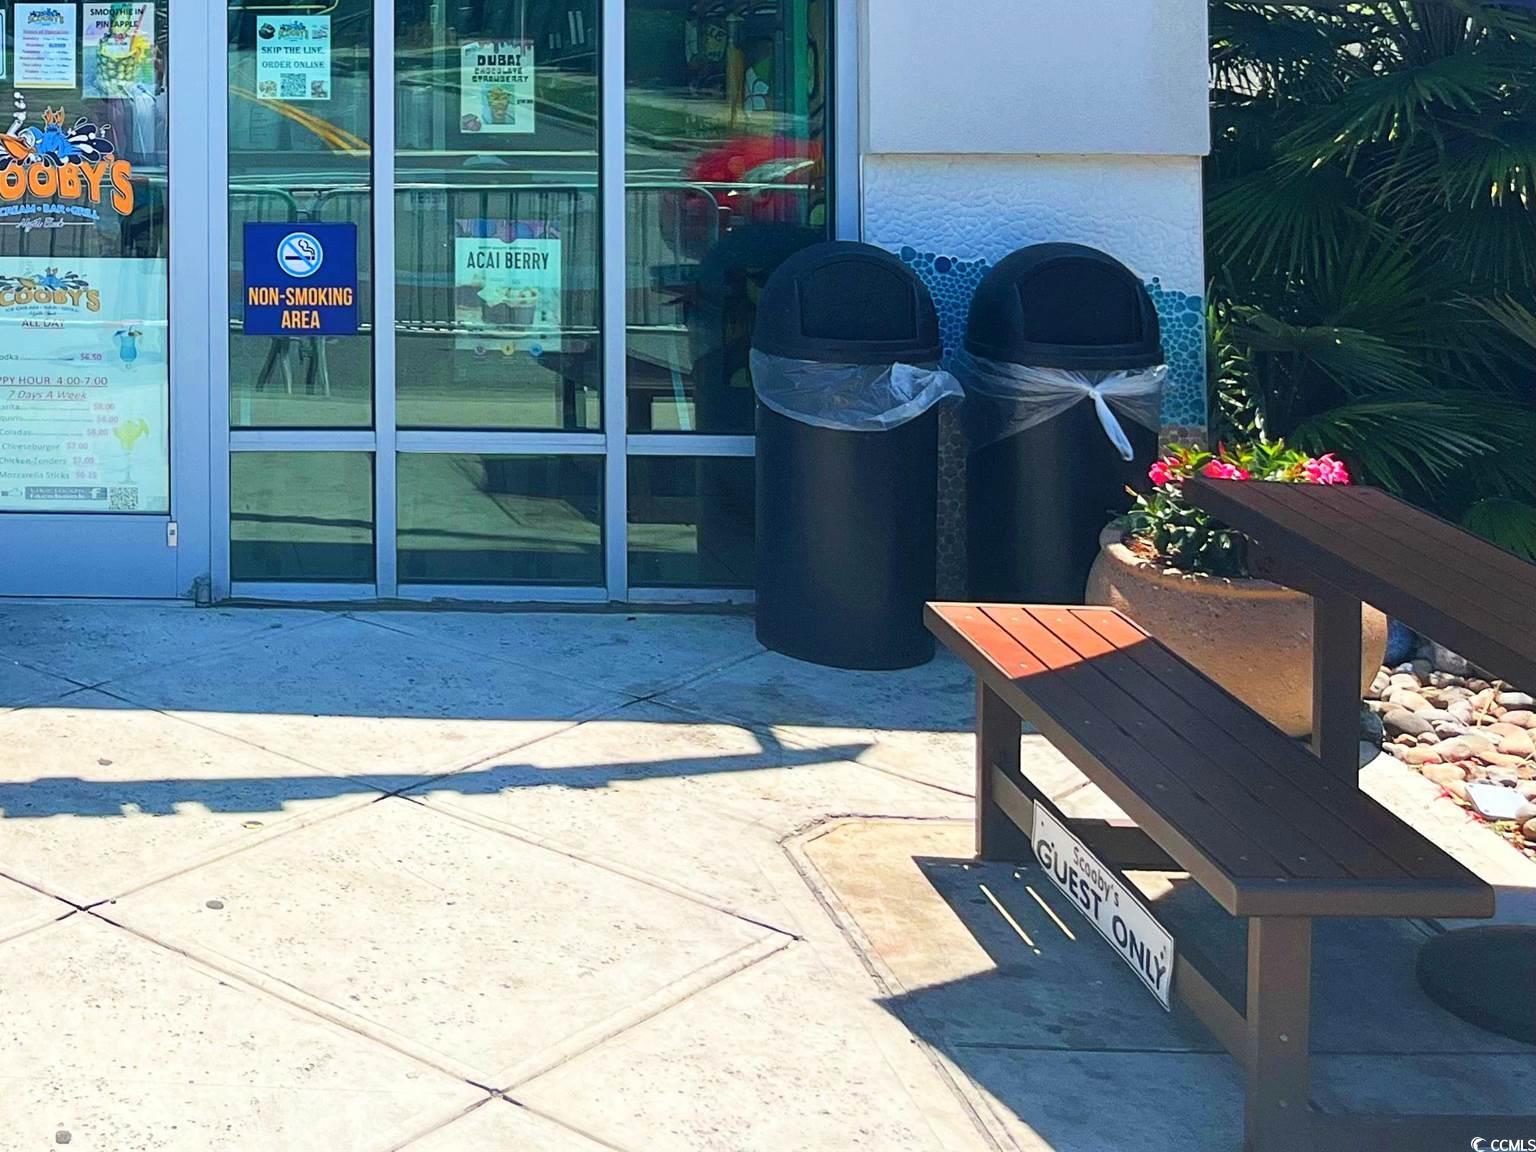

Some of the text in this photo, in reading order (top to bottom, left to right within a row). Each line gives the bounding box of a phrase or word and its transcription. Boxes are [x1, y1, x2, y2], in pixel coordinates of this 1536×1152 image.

[90, 8, 144, 16] SMOOTHIE IN
[96, 20, 139, 28] PINEAPPLE
[261, 46, 282, 54] SKIP
[284, 46, 301, 54] THE
[262, 61, 325, 69] ORDER ONLINE
[477, 54, 521, 66] DUBAI
[467, 251, 549, 270] ACAI BERRY
[248, 287, 353, 306] NON-SMOKING
[21, 320, 40, 328] ALL
[281, 310, 321, 329] AREA
[8, 390, 87, 401] 7 Days A Week
[1073, 845, 1120, 908] Scooby's
[1036, 839, 1167, 990] GUEST ONLY
